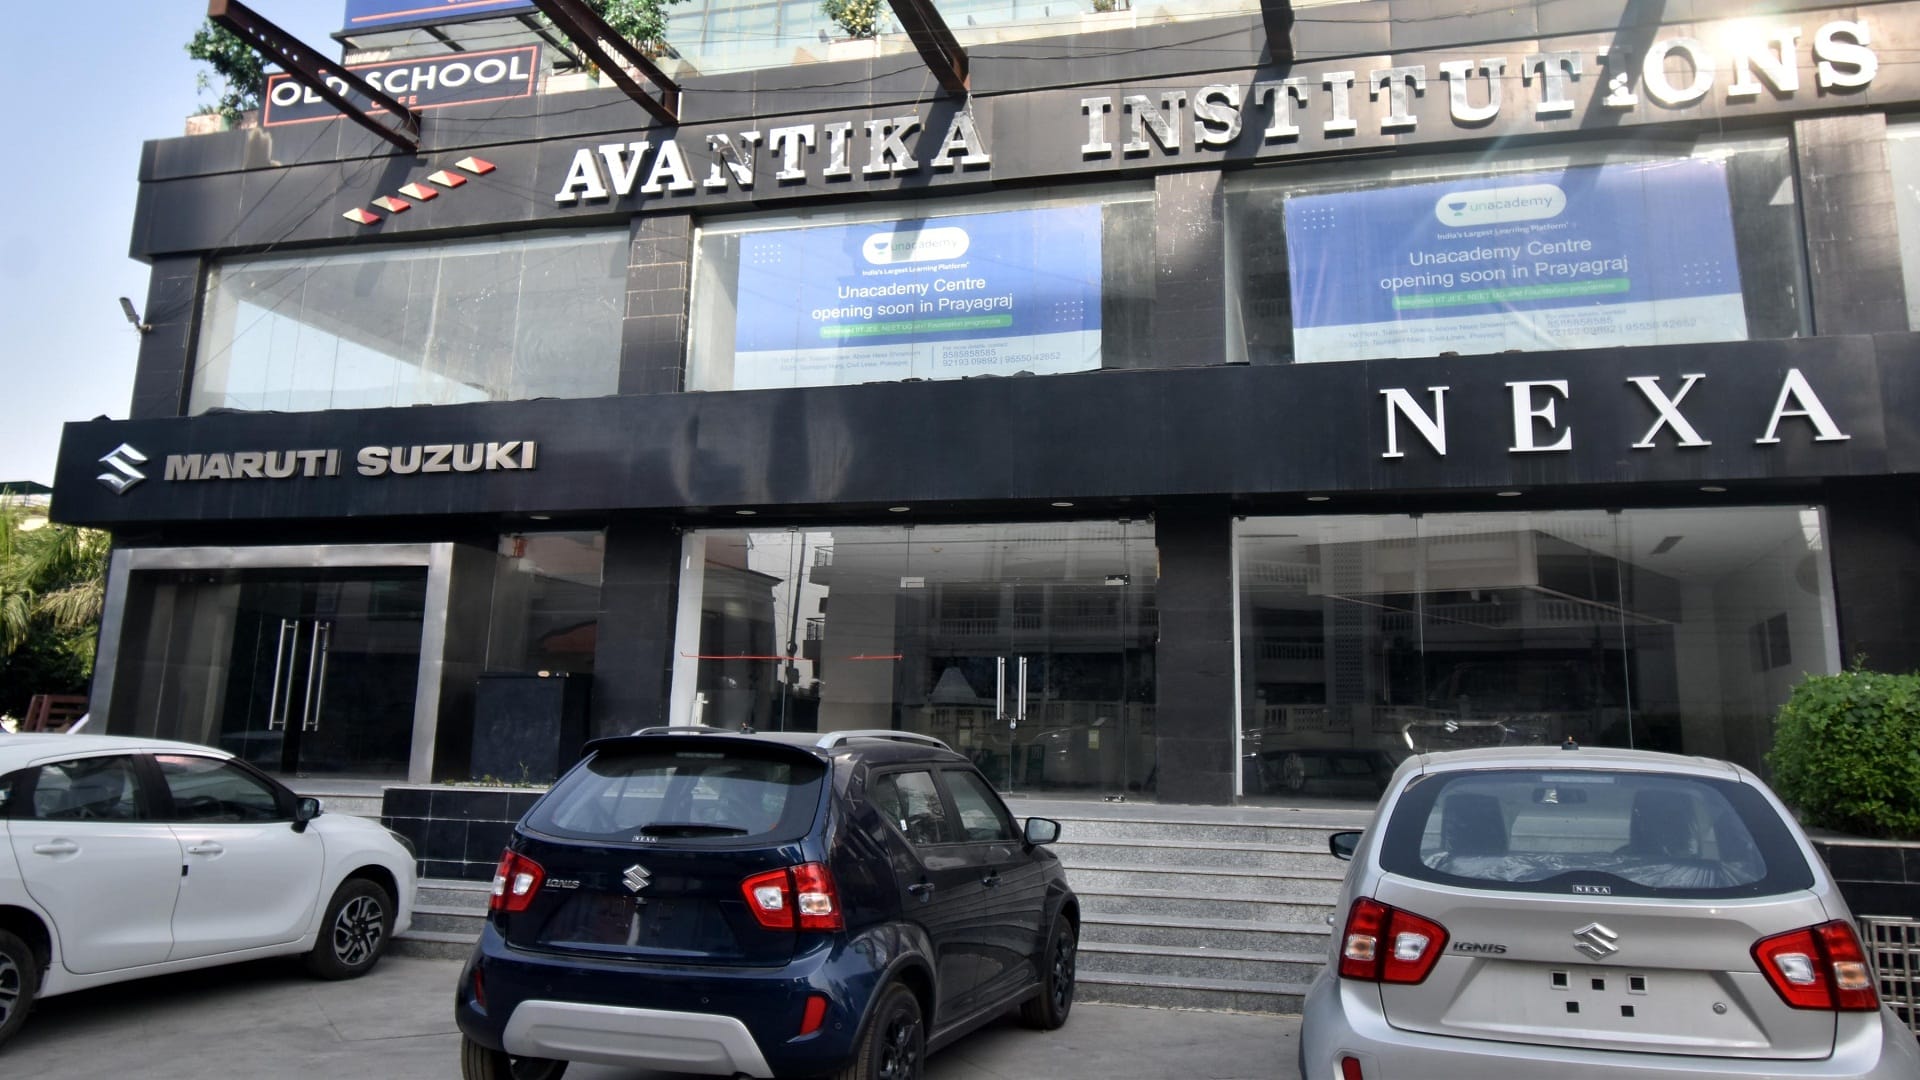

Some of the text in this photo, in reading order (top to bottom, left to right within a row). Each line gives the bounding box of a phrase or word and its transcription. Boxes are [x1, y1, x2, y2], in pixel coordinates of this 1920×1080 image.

[365, 56, 529, 95] SCHOOL
[1080, 19, 1880, 156] INSTITUTIONS
[371, 96, 417, 109] CFE
[554, 110, 991, 202] AVANTIKA
[1470, 197, 1553, 212] unacademy
[1437, 231, 1463, 240] India's
[1464, 229, 1494, 239] Largest
[1409, 237, 1592, 266] Unacademy Centre
[862, 267, 884, 277] India's
[884, 266, 908, 276] Largest
[1380, 254, 1629, 290] opening soon in Prayagraj
[838, 277, 986, 299] Unacademy Centre
[811, 293, 1013, 322] opening soon in Prayagraj
[1379, 368, 1852, 459] NEXA
[163, 440, 537, 481] MARUTI SUZUKI
[546, 878, 580, 889] IGNIS
[1575, 886, 1609, 894] NEXA
[1453, 941, 1507, 954] IGNIS
